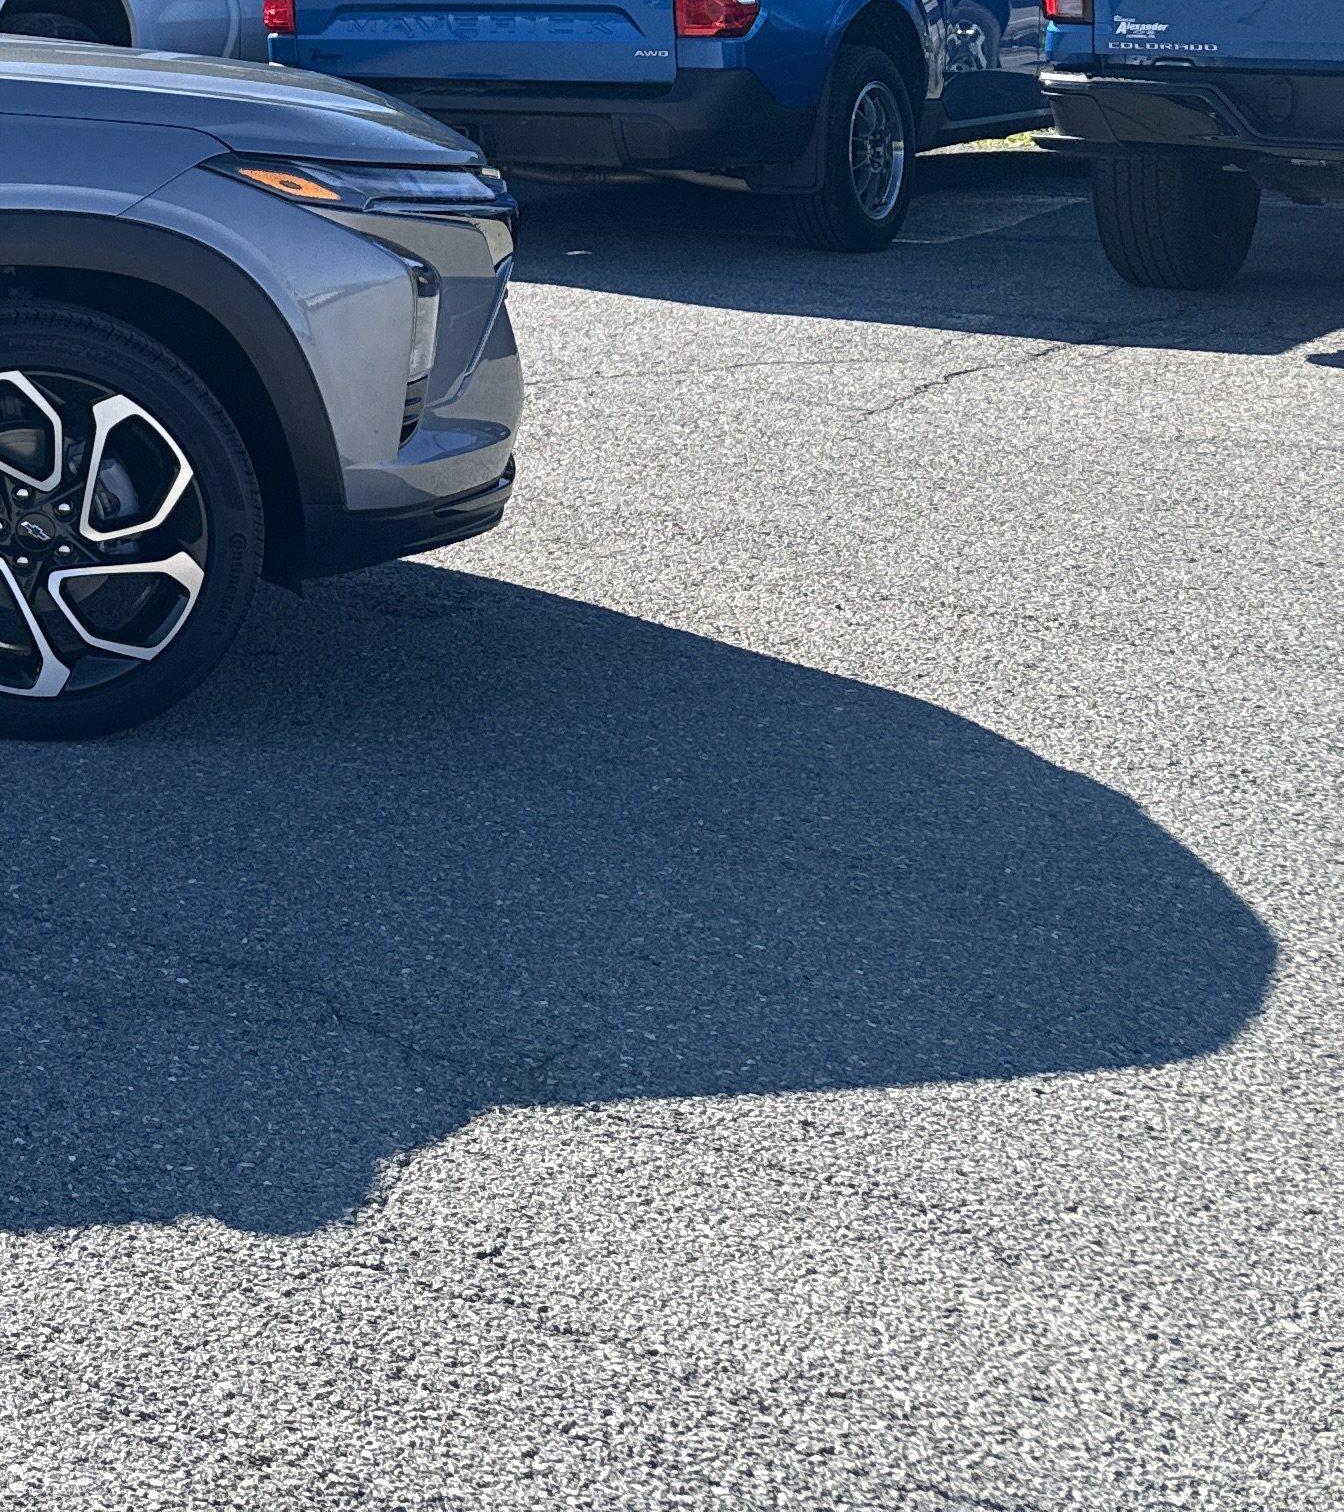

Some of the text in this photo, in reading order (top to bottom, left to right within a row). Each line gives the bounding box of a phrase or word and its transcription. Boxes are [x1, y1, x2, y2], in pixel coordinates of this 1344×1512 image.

[347, 14, 613, 35] MAVERICK
[1108, 41, 1218, 51] COLORADO
[634, 49, 669, 57] AWD
